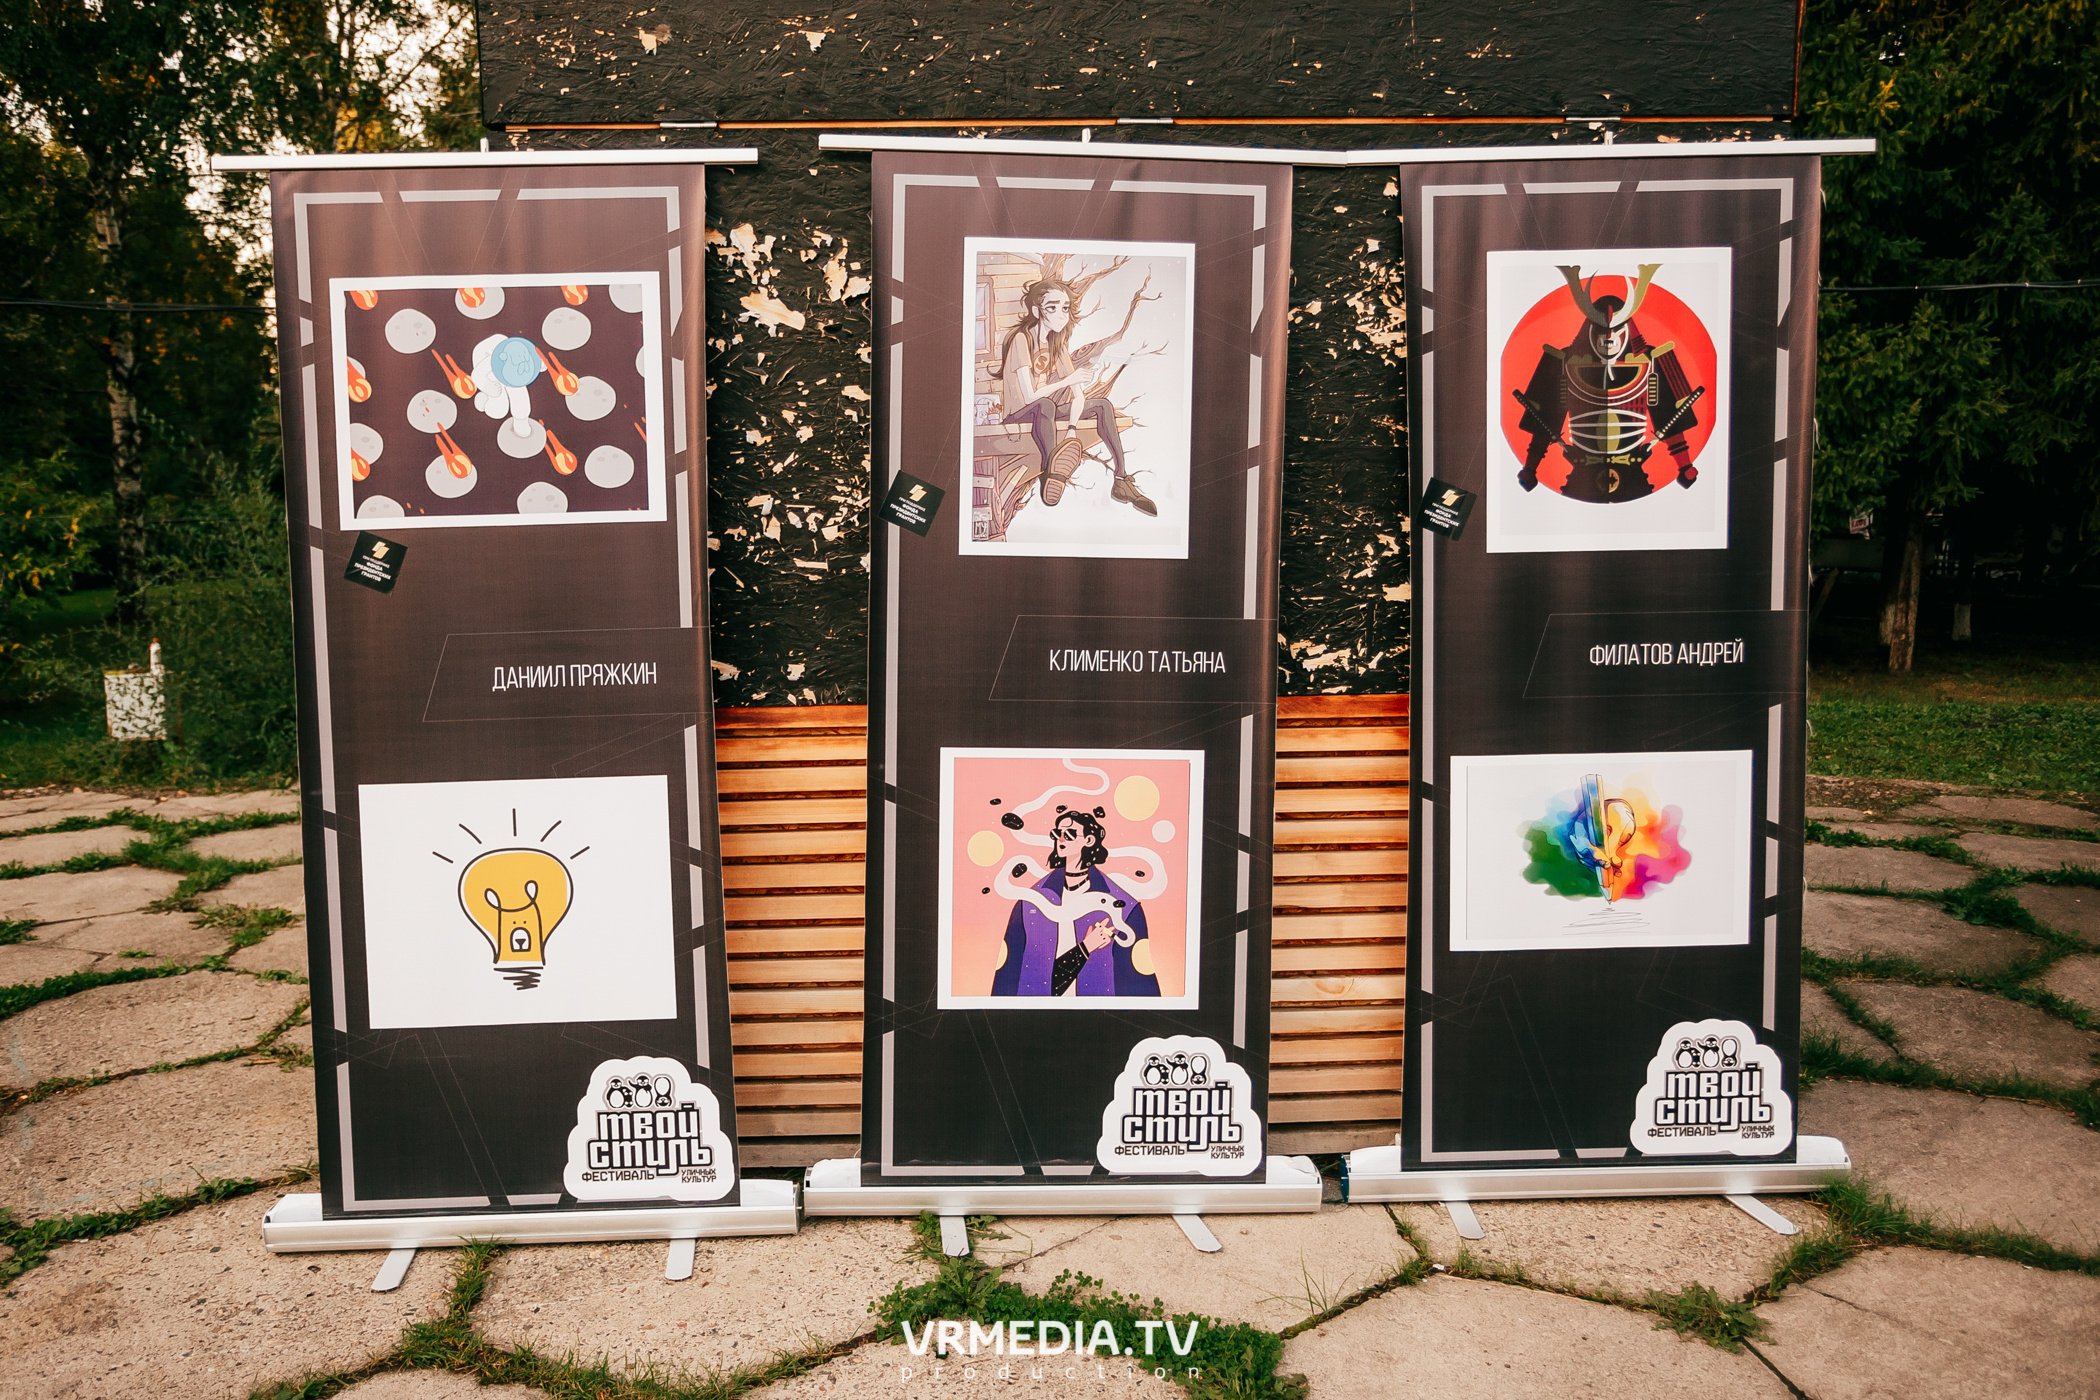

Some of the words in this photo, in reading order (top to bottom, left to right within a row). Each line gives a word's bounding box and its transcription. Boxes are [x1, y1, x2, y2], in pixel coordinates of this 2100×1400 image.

[1590, 643, 1673, 666] ФИЛАТОВ
[1677, 638, 1744, 666] АНДРЕЙ
[1050, 649, 1143, 672] КЛИМЕНКО
[1148, 651, 1226, 673] ТАТЬЯНА
[492, 665, 566, 692] ДАНИИЛ
[570, 662, 657, 686] ПРЯЖКИН
[1648, 1127, 1717, 1138] ФЕСТИВАЛЬ
[1114, 1146, 1185, 1155] ФЕСТИВАЛЬ
[582, 1170, 654, 1182] ФЕСТИВАЛЬ
[681, 1168, 716, 1176] УЛИЧНЫХ
